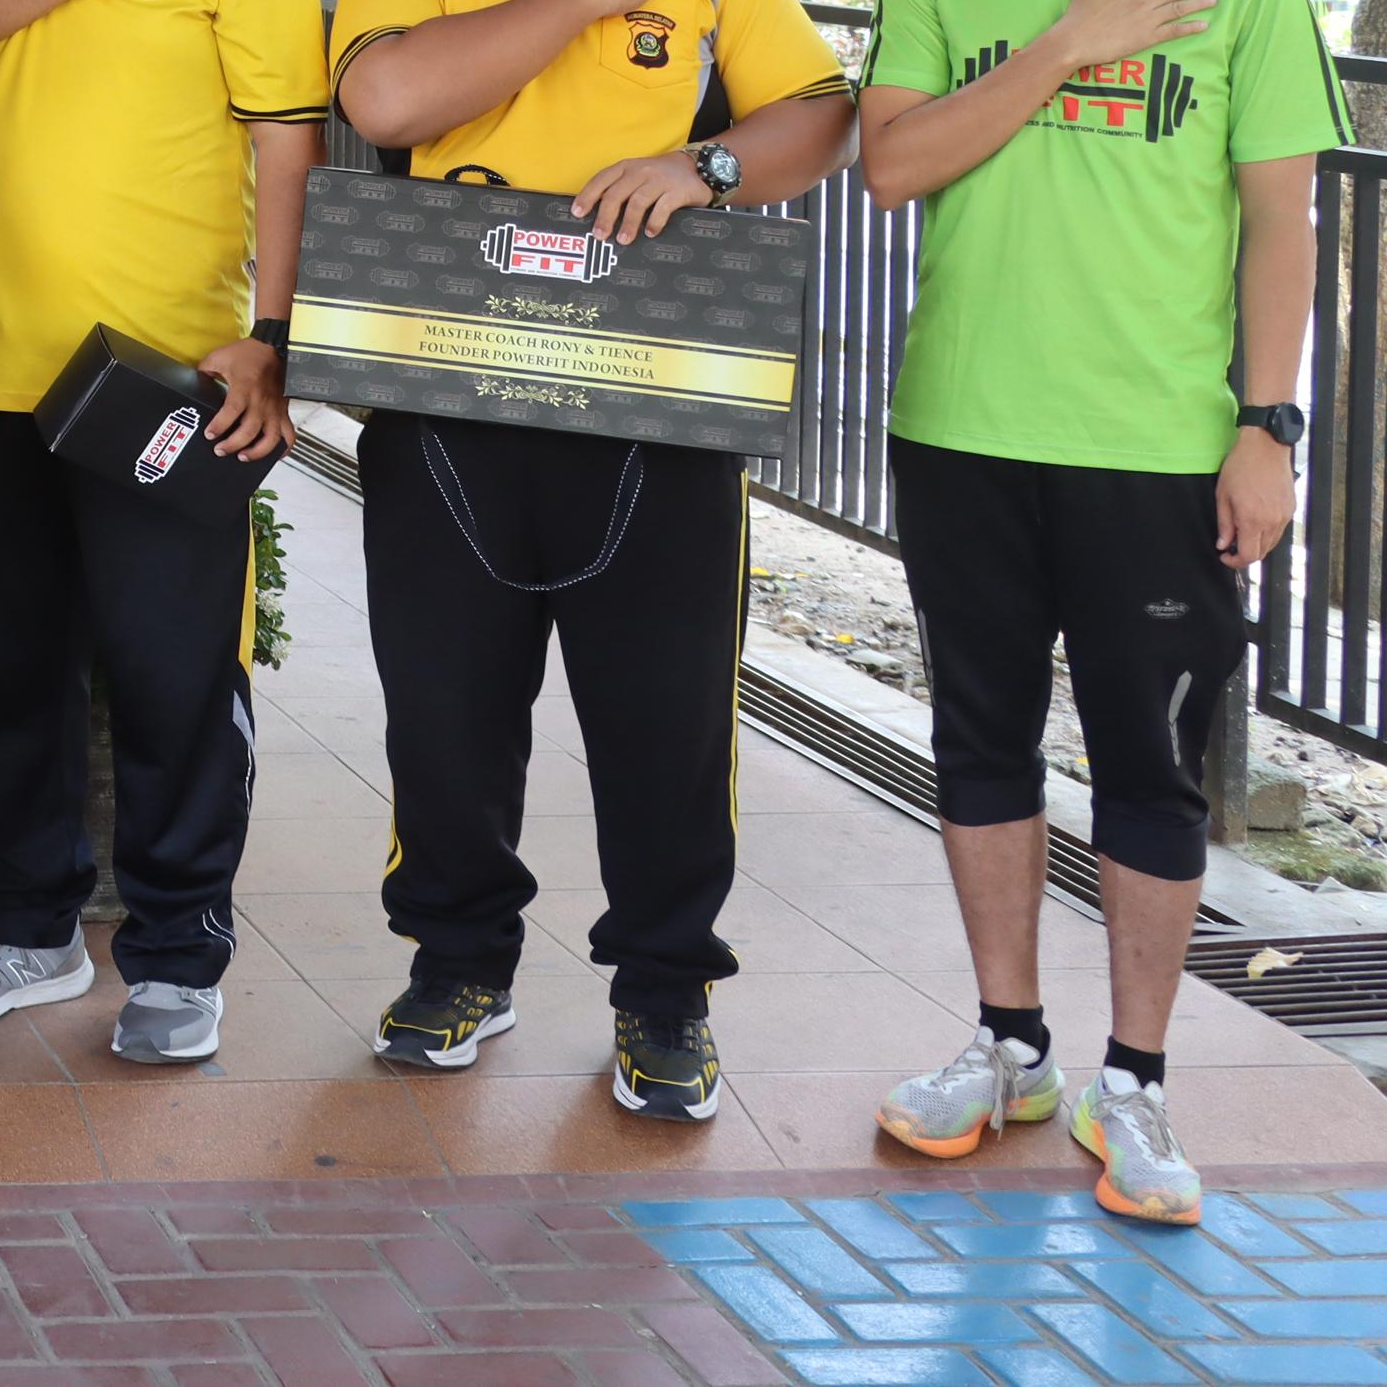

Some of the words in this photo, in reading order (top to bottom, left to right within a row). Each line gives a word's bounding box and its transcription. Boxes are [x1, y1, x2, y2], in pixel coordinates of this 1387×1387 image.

[514, 231, 585, 252] POWER
[511, 254, 584, 273] FIT
[419, 341, 489, 359] FOUNDER
[492, 350, 570, 369] POWERFIT
[572, 360, 655, 380] INDONESIA
[424, 324, 482, 342] MASTER
[486, 332, 537, 348] COACH
[541, 338, 583, 354] RONY
[584, 345, 594, 356] &
[598, 346, 654, 362] TIENCE
[144, 421, 177, 463] POWER
[157, 426, 186, 469] FIT
